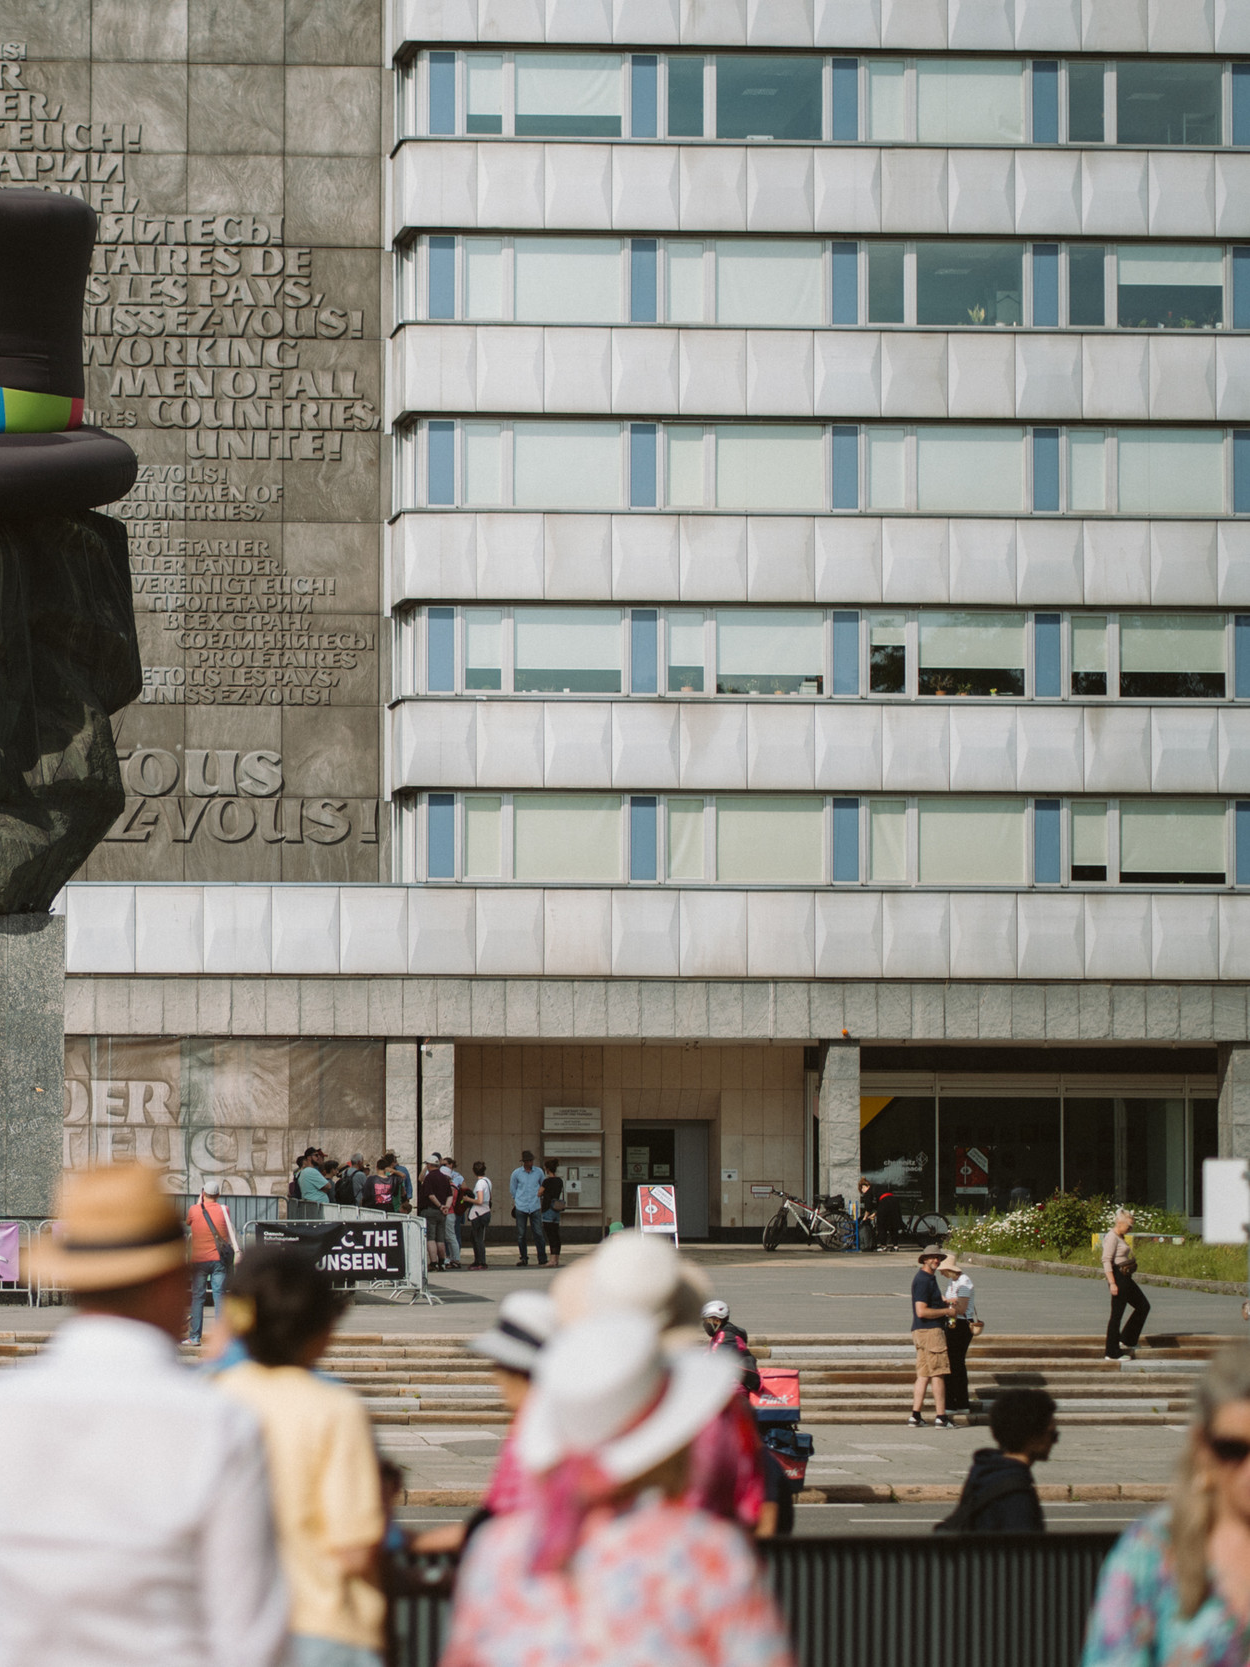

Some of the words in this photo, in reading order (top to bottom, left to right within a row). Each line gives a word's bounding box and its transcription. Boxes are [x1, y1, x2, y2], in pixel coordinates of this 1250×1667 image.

[8, 122, 142, 153] EUCH!
[250, 248, 312, 277] DE
[117, 275, 188, 307] LES
[198, 277, 326, 308] PAYS,
[83, 337, 301, 369] WORKING
[110, 368, 214, 399] MEN
[220, 369, 283, 400] OF
[286, 370, 365, 400] ALL
[149, 400, 381, 432] COUNTRIES,
[185, 430, 343, 461] UNITE!
[187, 484, 247, 503] MEN
[252, 485, 284, 504] OF
[132, 575, 256, 595] VEREINIGT
[261, 577, 336, 596] EUCH!
[162, 612, 225, 631] ВСЕХ
[228, 668, 269, 688] LES
[759, 1394, 789, 1405] Flink
